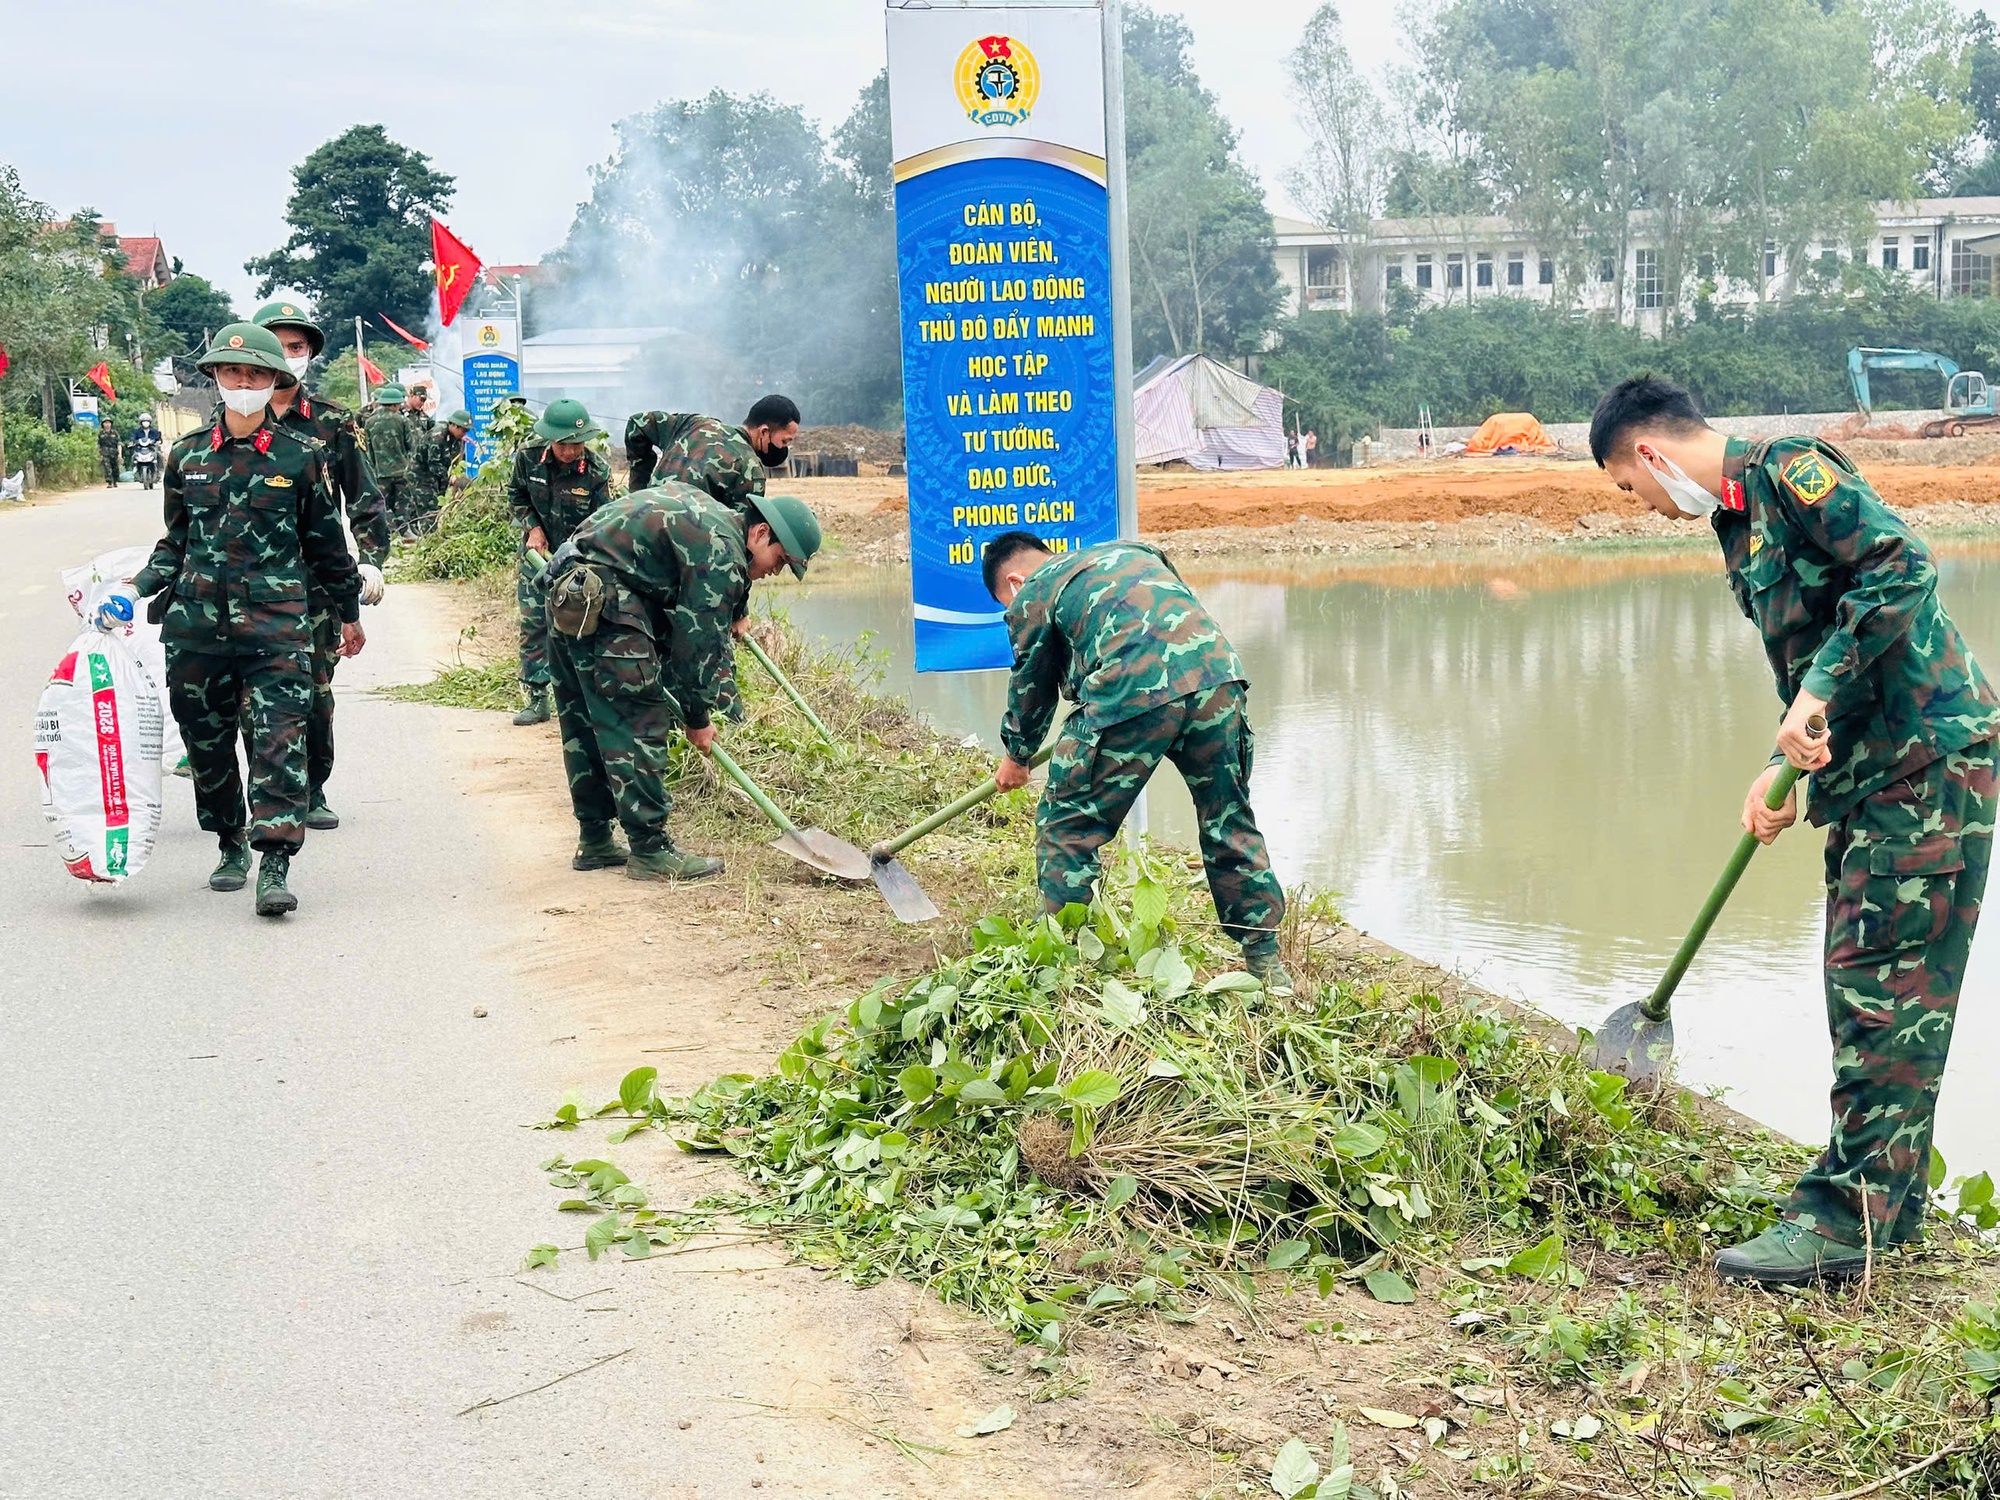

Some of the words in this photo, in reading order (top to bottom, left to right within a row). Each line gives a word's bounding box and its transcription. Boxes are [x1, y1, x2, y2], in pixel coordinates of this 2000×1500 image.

[964, 199, 1004, 226] CÁN
[1010, 198, 1042, 230] BỘ,
[949, 237, 1003, 265] ĐOÀN
[1008, 236, 1059, 264] VIÊN,
[925, 276, 986, 304] NGƯỜI
[991, 279, 1027, 302] LAO
[1032, 274, 1085, 305] ĐỘNG
[918, 312, 955, 343] THỦ
[961, 314, 988, 341] ĐÔ
[993, 308, 1030, 340] ĐẨY
[1036, 315, 1094, 342] MẠNH
[968, 356, 1007, 382] HỌC
[1012, 350, 1049, 380] TẬP
[946, 390, 972, 416] VÀ
[978, 388, 1019, 415] LÀM
[1024, 390, 1072, 412] THEO
[962, 428, 987, 453] TƯ
[991, 422, 1060, 452] TƯỞNG,
[968, 467, 1007, 493] ĐẠO
[1012, 461, 1057, 488] ĐỨC,
[952, 503, 1018, 527] PHONG
[1024, 498, 1075, 524] CÁCH
[948, 535, 974, 565] HỒ
[97, 700, 115, 735] 3202
